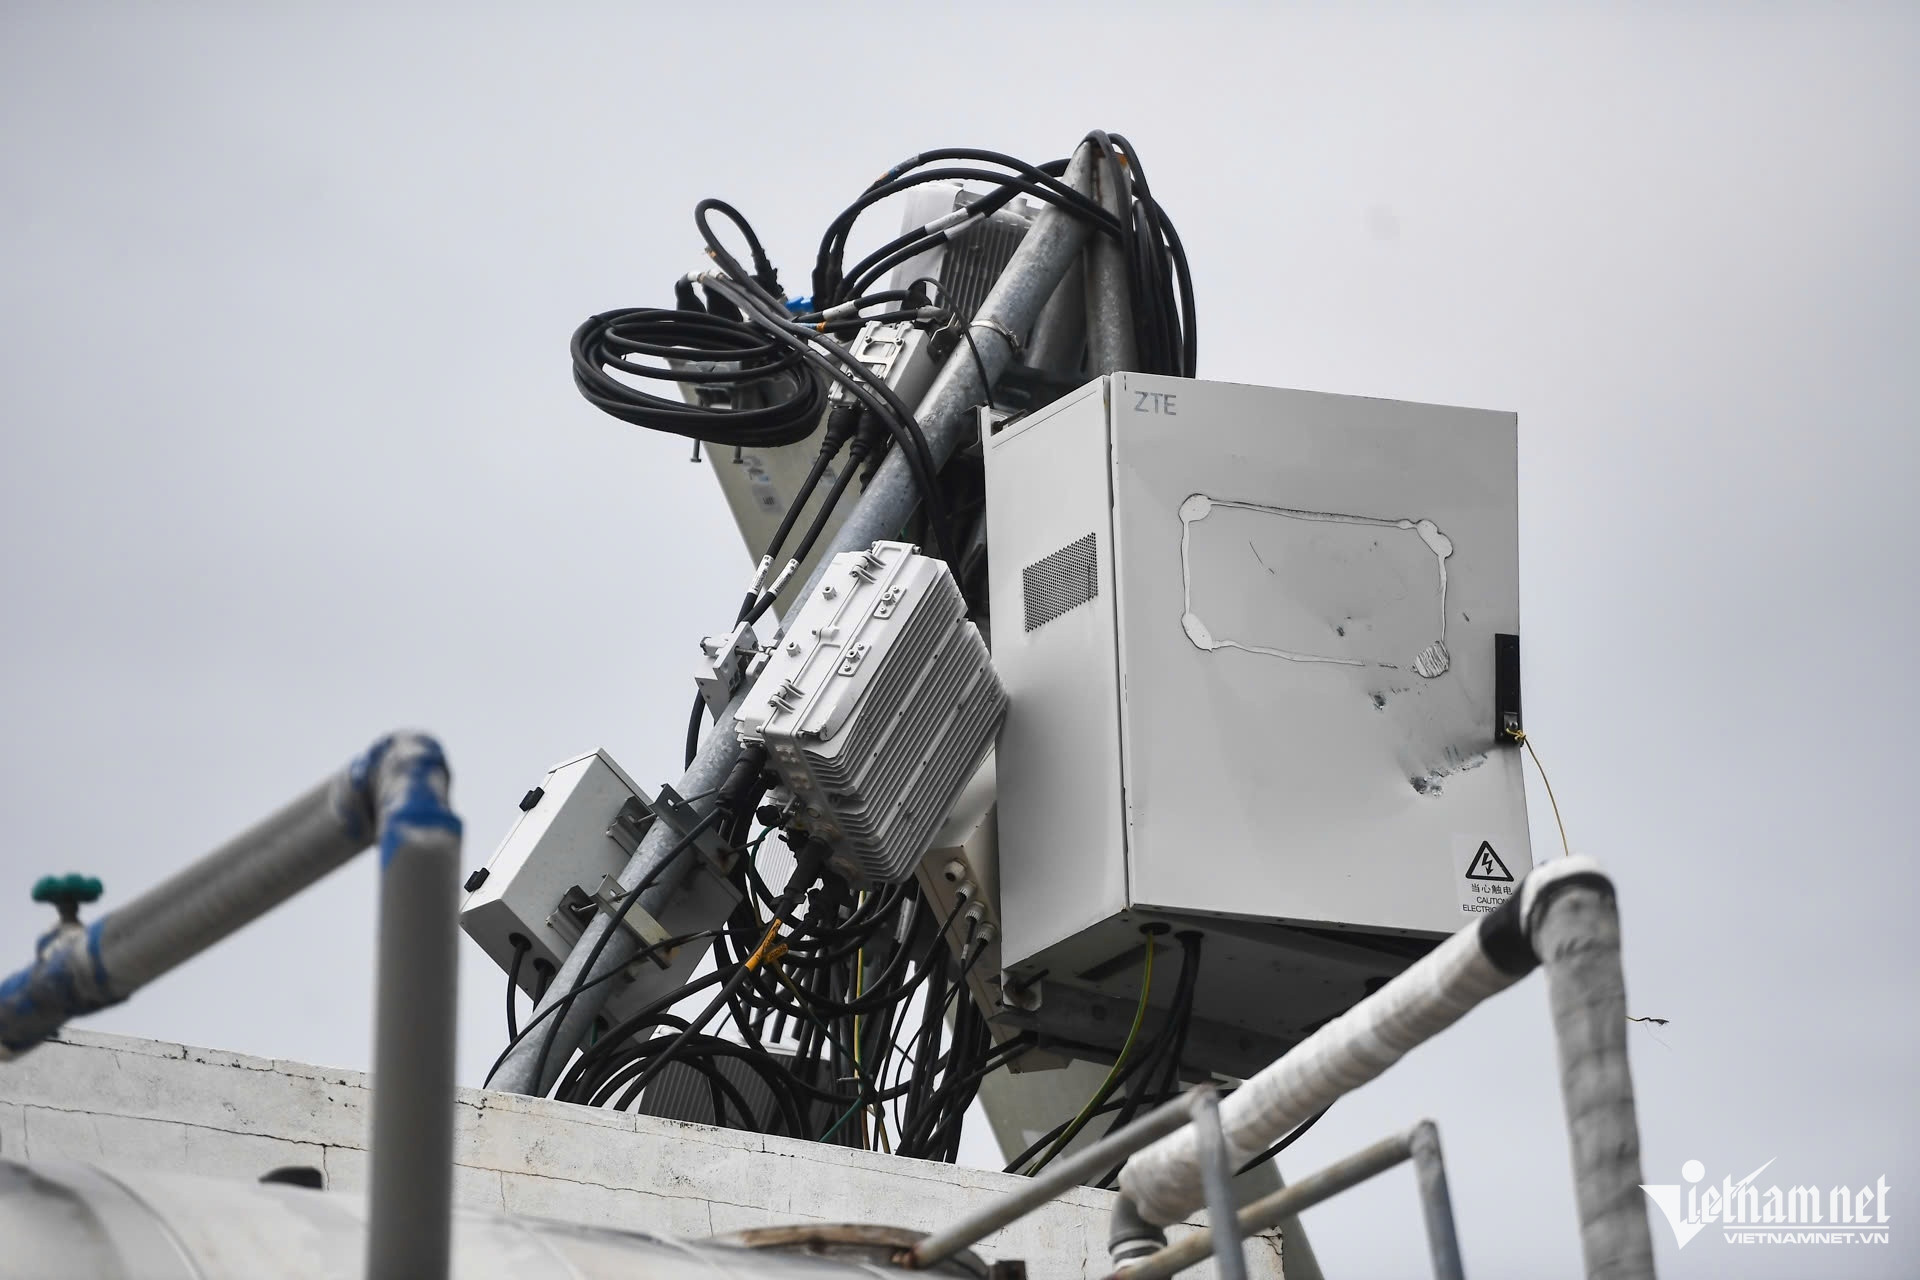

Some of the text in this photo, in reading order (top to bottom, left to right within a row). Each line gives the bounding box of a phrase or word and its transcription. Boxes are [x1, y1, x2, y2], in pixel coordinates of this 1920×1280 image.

[1134, 390, 1177, 416] ZTE
[1471, 883, 1513, 896] 当心触电
